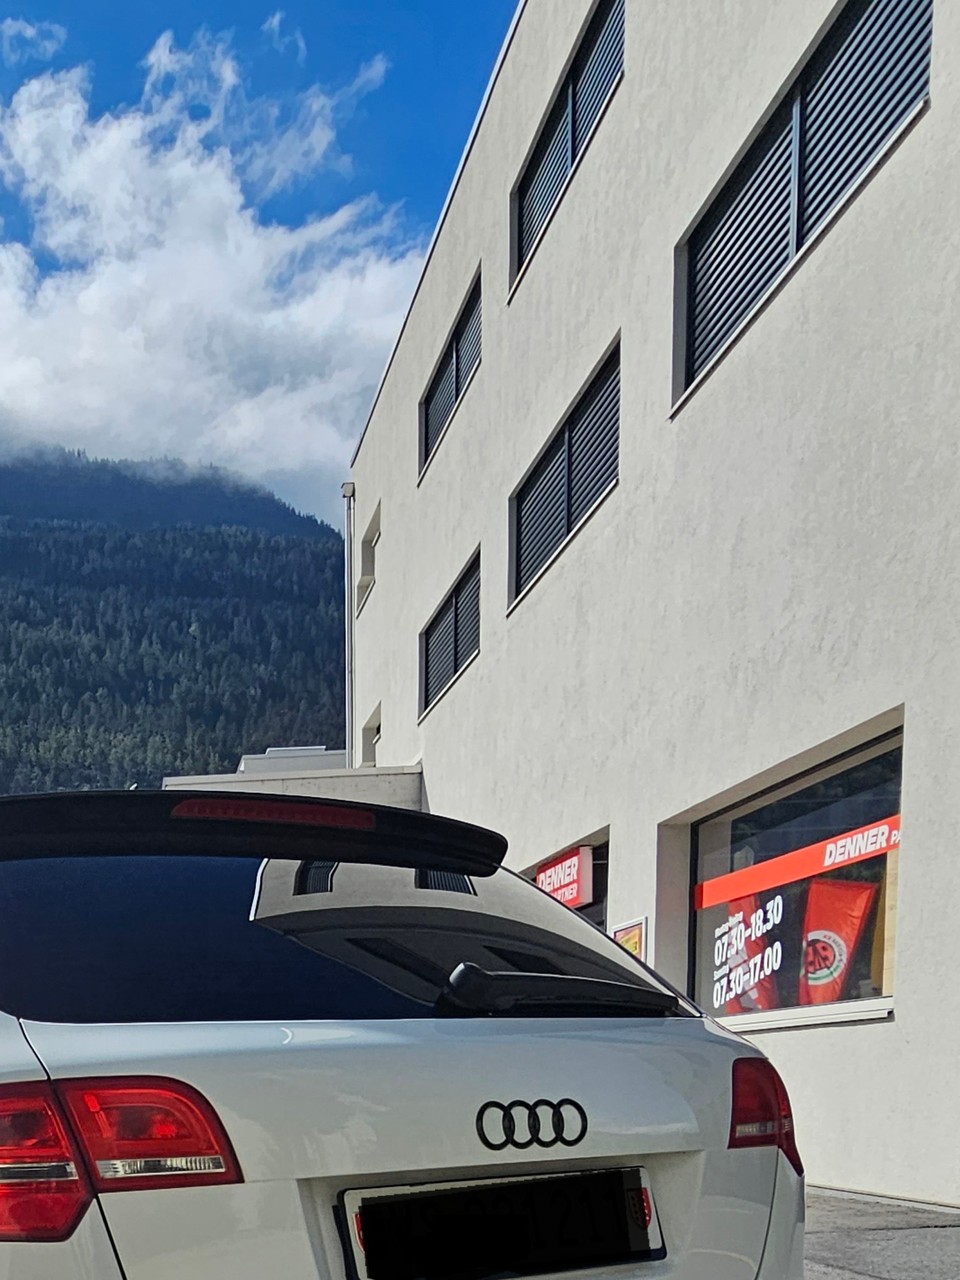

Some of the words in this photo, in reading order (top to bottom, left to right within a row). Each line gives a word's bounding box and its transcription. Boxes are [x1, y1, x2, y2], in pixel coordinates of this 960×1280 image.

[823, 824, 889, 867] DENNER
[539, 856, 579, 893] DENNER
[714, 895, 783, 966] 07.30-18.30
[713, 941, 782, 1008] 07.30-17.00
